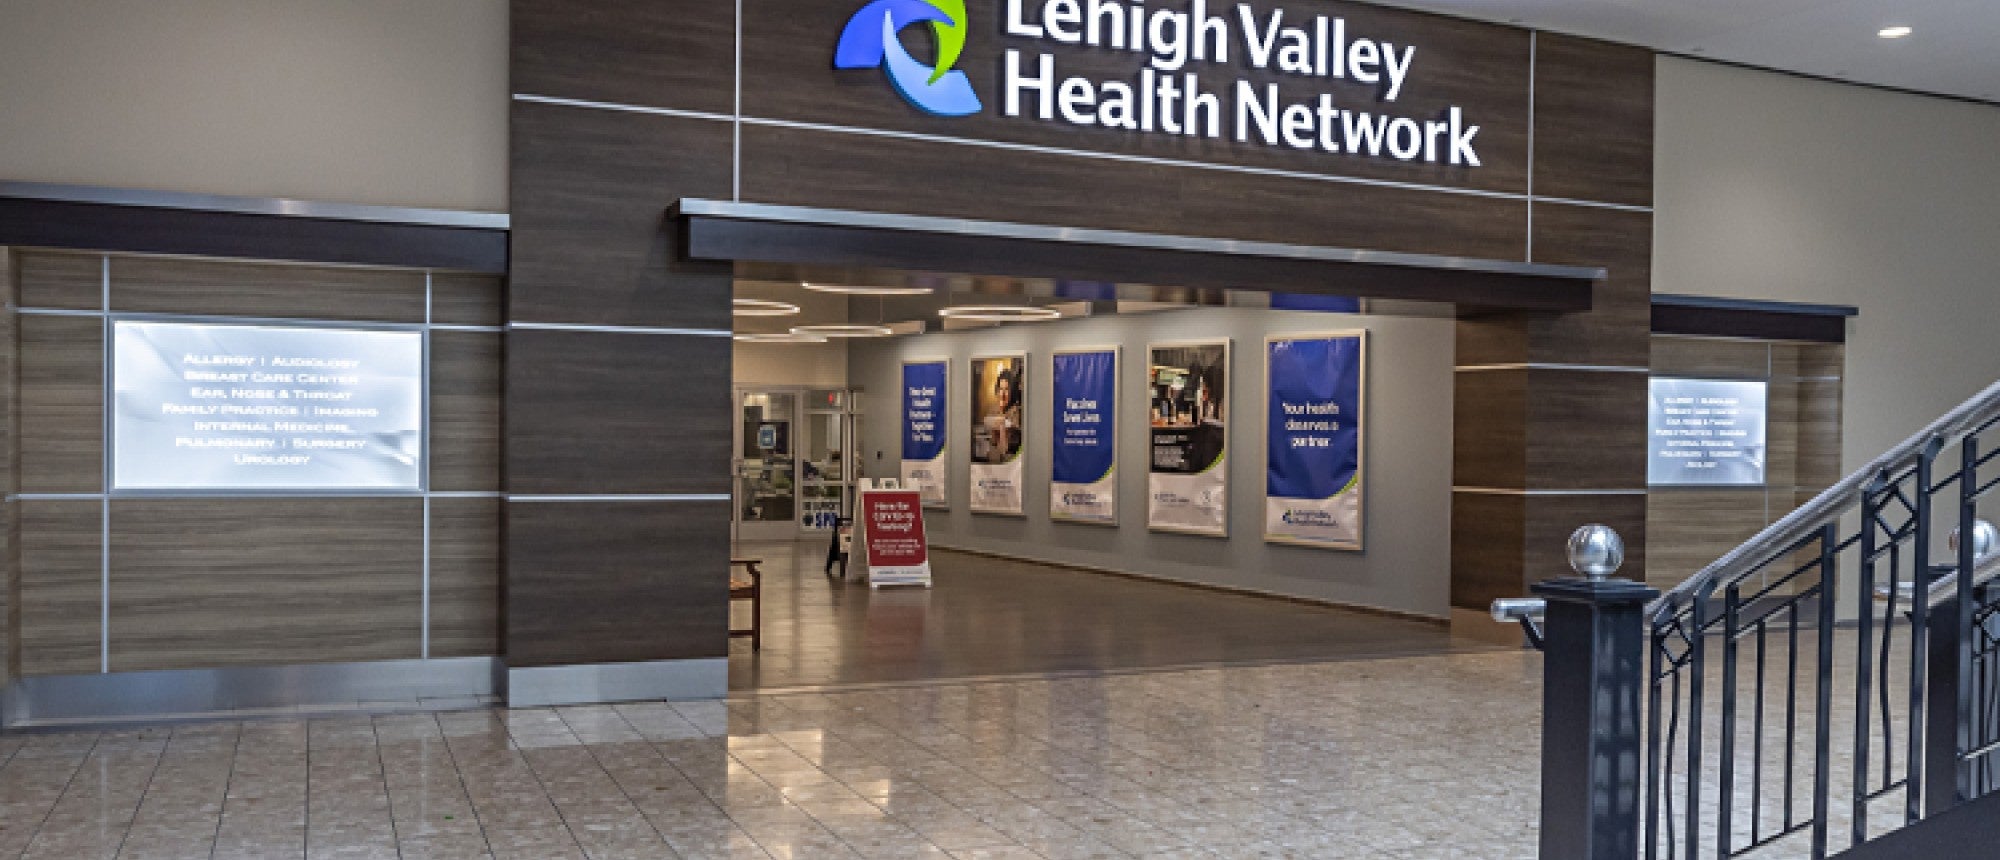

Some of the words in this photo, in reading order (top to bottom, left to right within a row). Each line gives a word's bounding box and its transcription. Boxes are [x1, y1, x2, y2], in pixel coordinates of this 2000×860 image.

[1004, 0, 1227, 71] Lehigh
[1236, 3, 1416, 101] Valley
[1004, 48, 1220, 139] Health
[1235, 80, 1483, 168] Network
[1306, 401, 1339, 414] health
